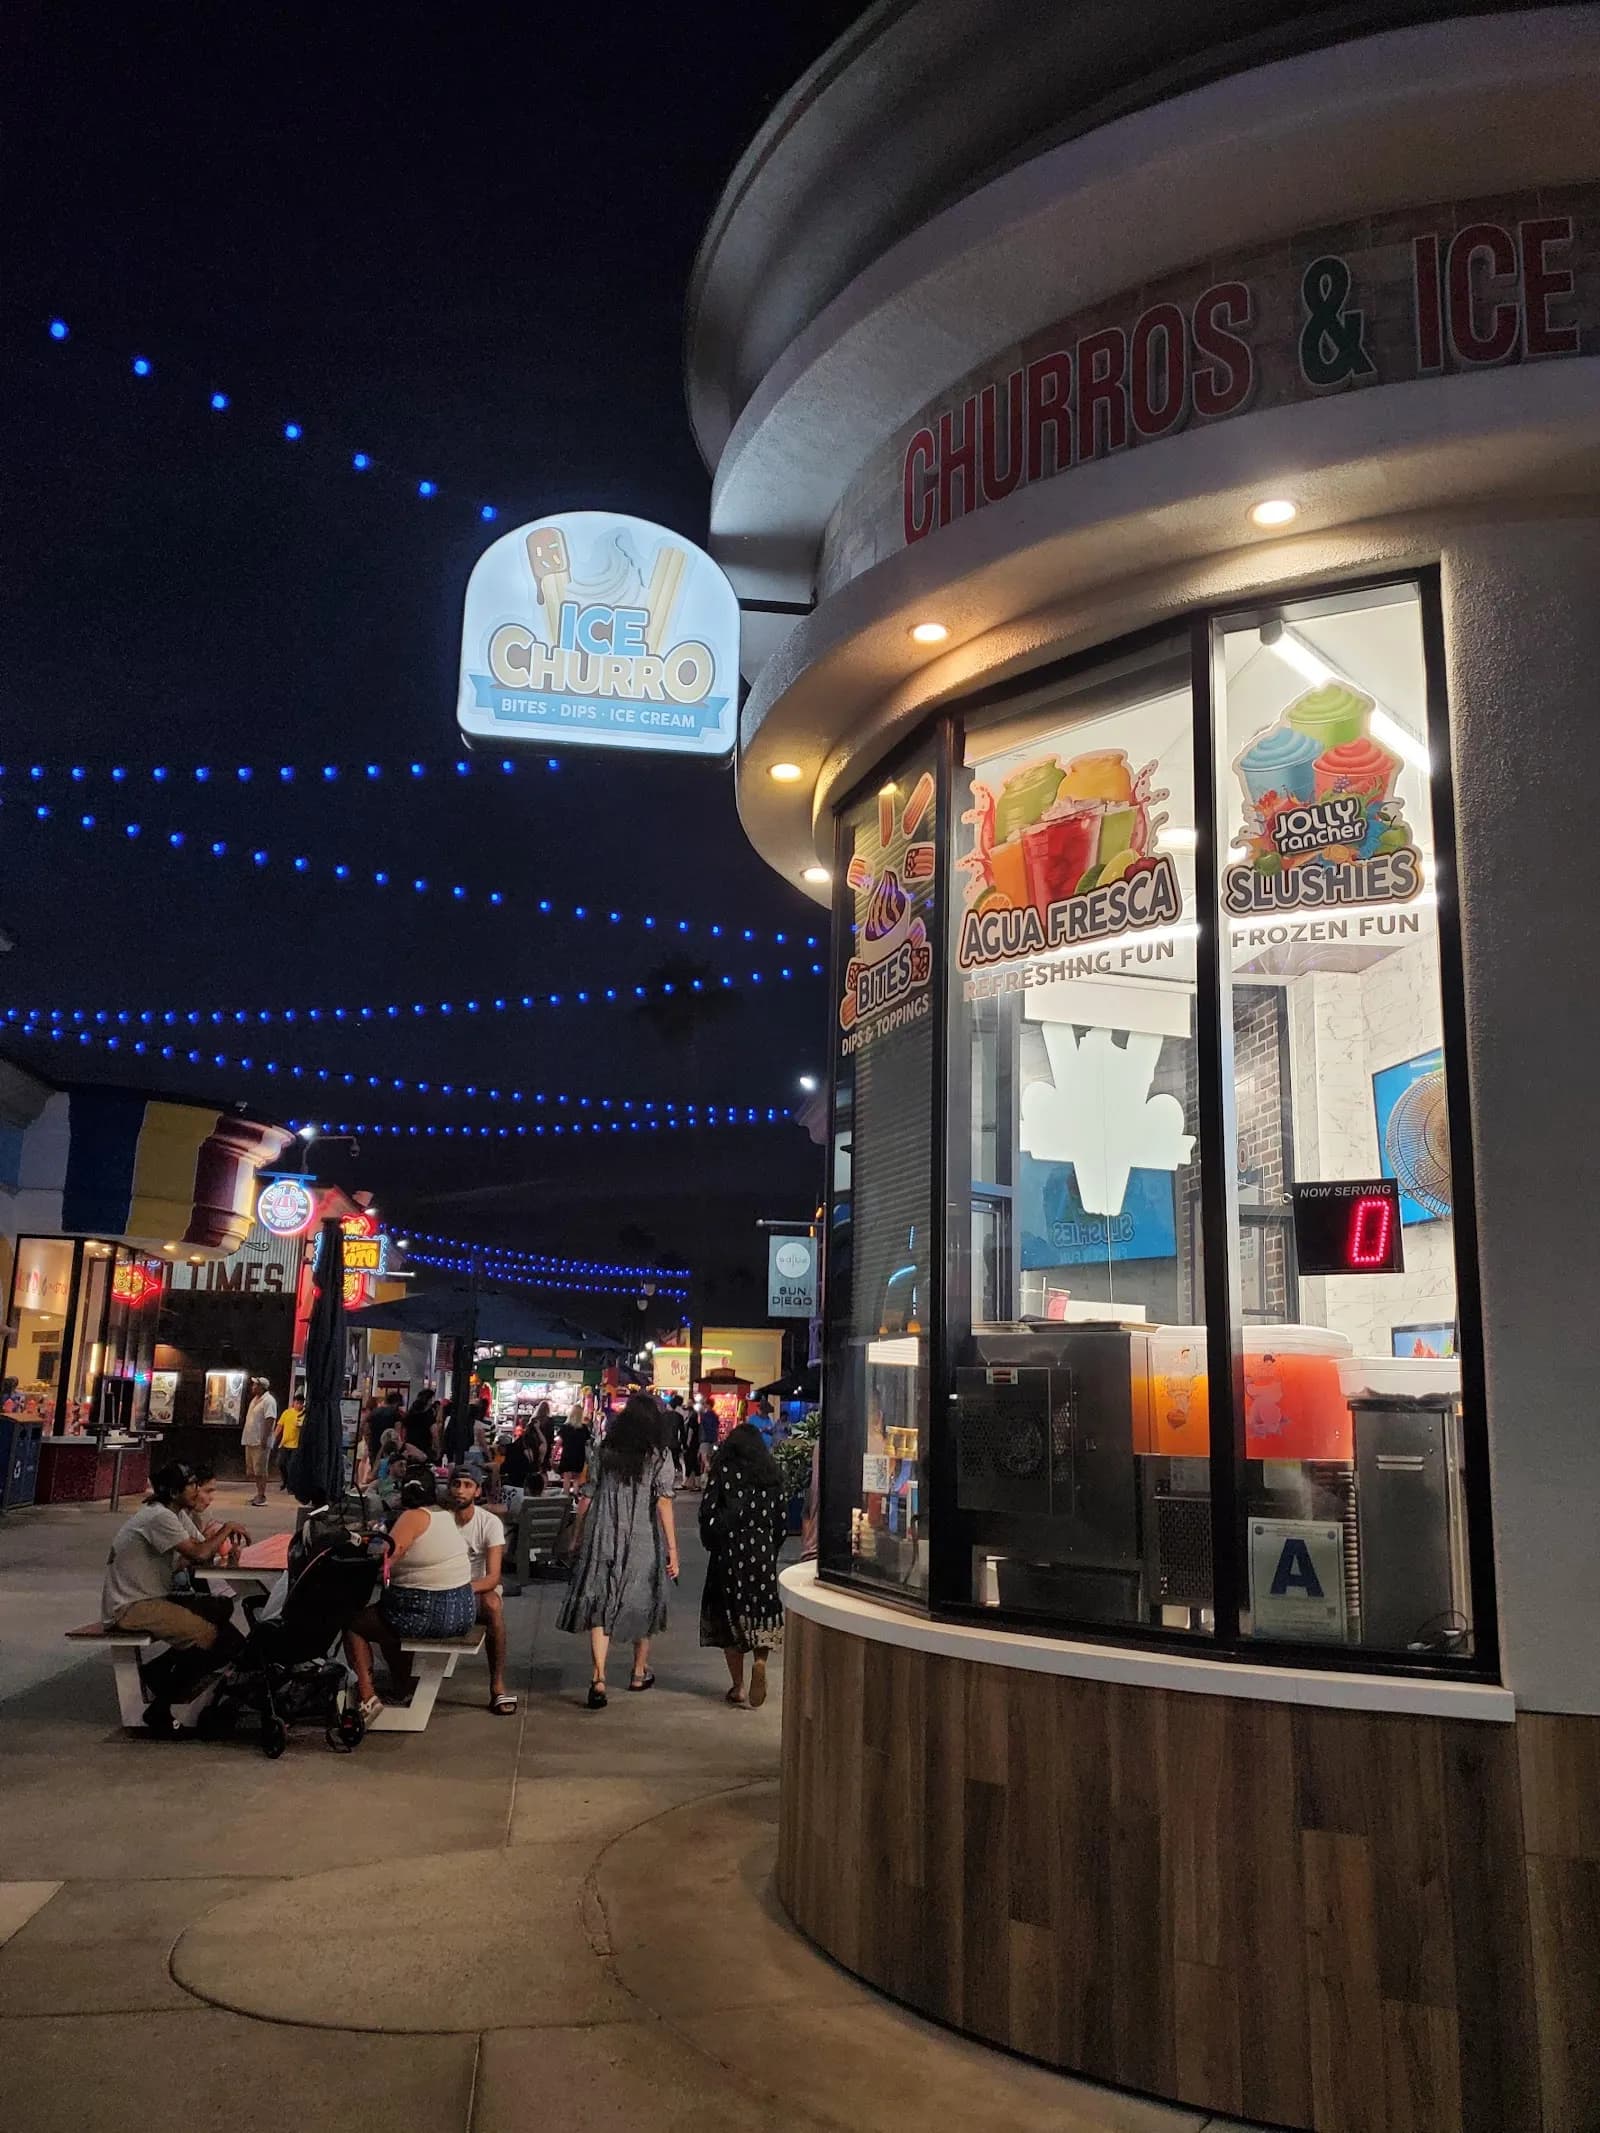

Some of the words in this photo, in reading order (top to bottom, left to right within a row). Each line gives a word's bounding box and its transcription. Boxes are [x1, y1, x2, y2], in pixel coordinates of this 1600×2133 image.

[902, 280, 1255, 547] CHURROS
[1300, 254, 1377, 389] &
[1411, 216, 1582, 373] ICE
[559, 602, 650, 657] ICE
[489, 623, 715, 704] CHURRO
[501, 698, 547, 715] BITES
[560, 704, 597, 720] DIPS
[609, 707, 635, 723] ICE
[640, 710, 695, 729] CREAM
[1275, 799, 1356, 840] JOLLY
[1280, 822, 1363, 853] rancher
[1228, 852, 1415, 909] SLUSHIES
[963, 911, 1043, 961] AGUA
[1050, 867, 1174, 942] FRESCA
[1231, 919, 1348, 947] FROZEN
[1359, 913, 1420, 937] FUN
[858, 947, 911, 1013] BITES
[964, 951, 1112, 1001] REFRESHING
[1120, 938, 1175, 968] FUN
[841, 1030, 865, 1057] DIPS
[876, 993, 930, 1038] TOPPINGS
[1300, 1186, 1332, 1198] NOW
[1334, 1184, 1392, 1197] SERVING
[1352, 1200, 1390, 1263] 0
[186, 1260, 284, 1293] TIMES
[772, 1296, 813, 1309] DIEGO
[779, 1286, 806, 1296] SUN
[1269, 1537, 1325, 1598] A
